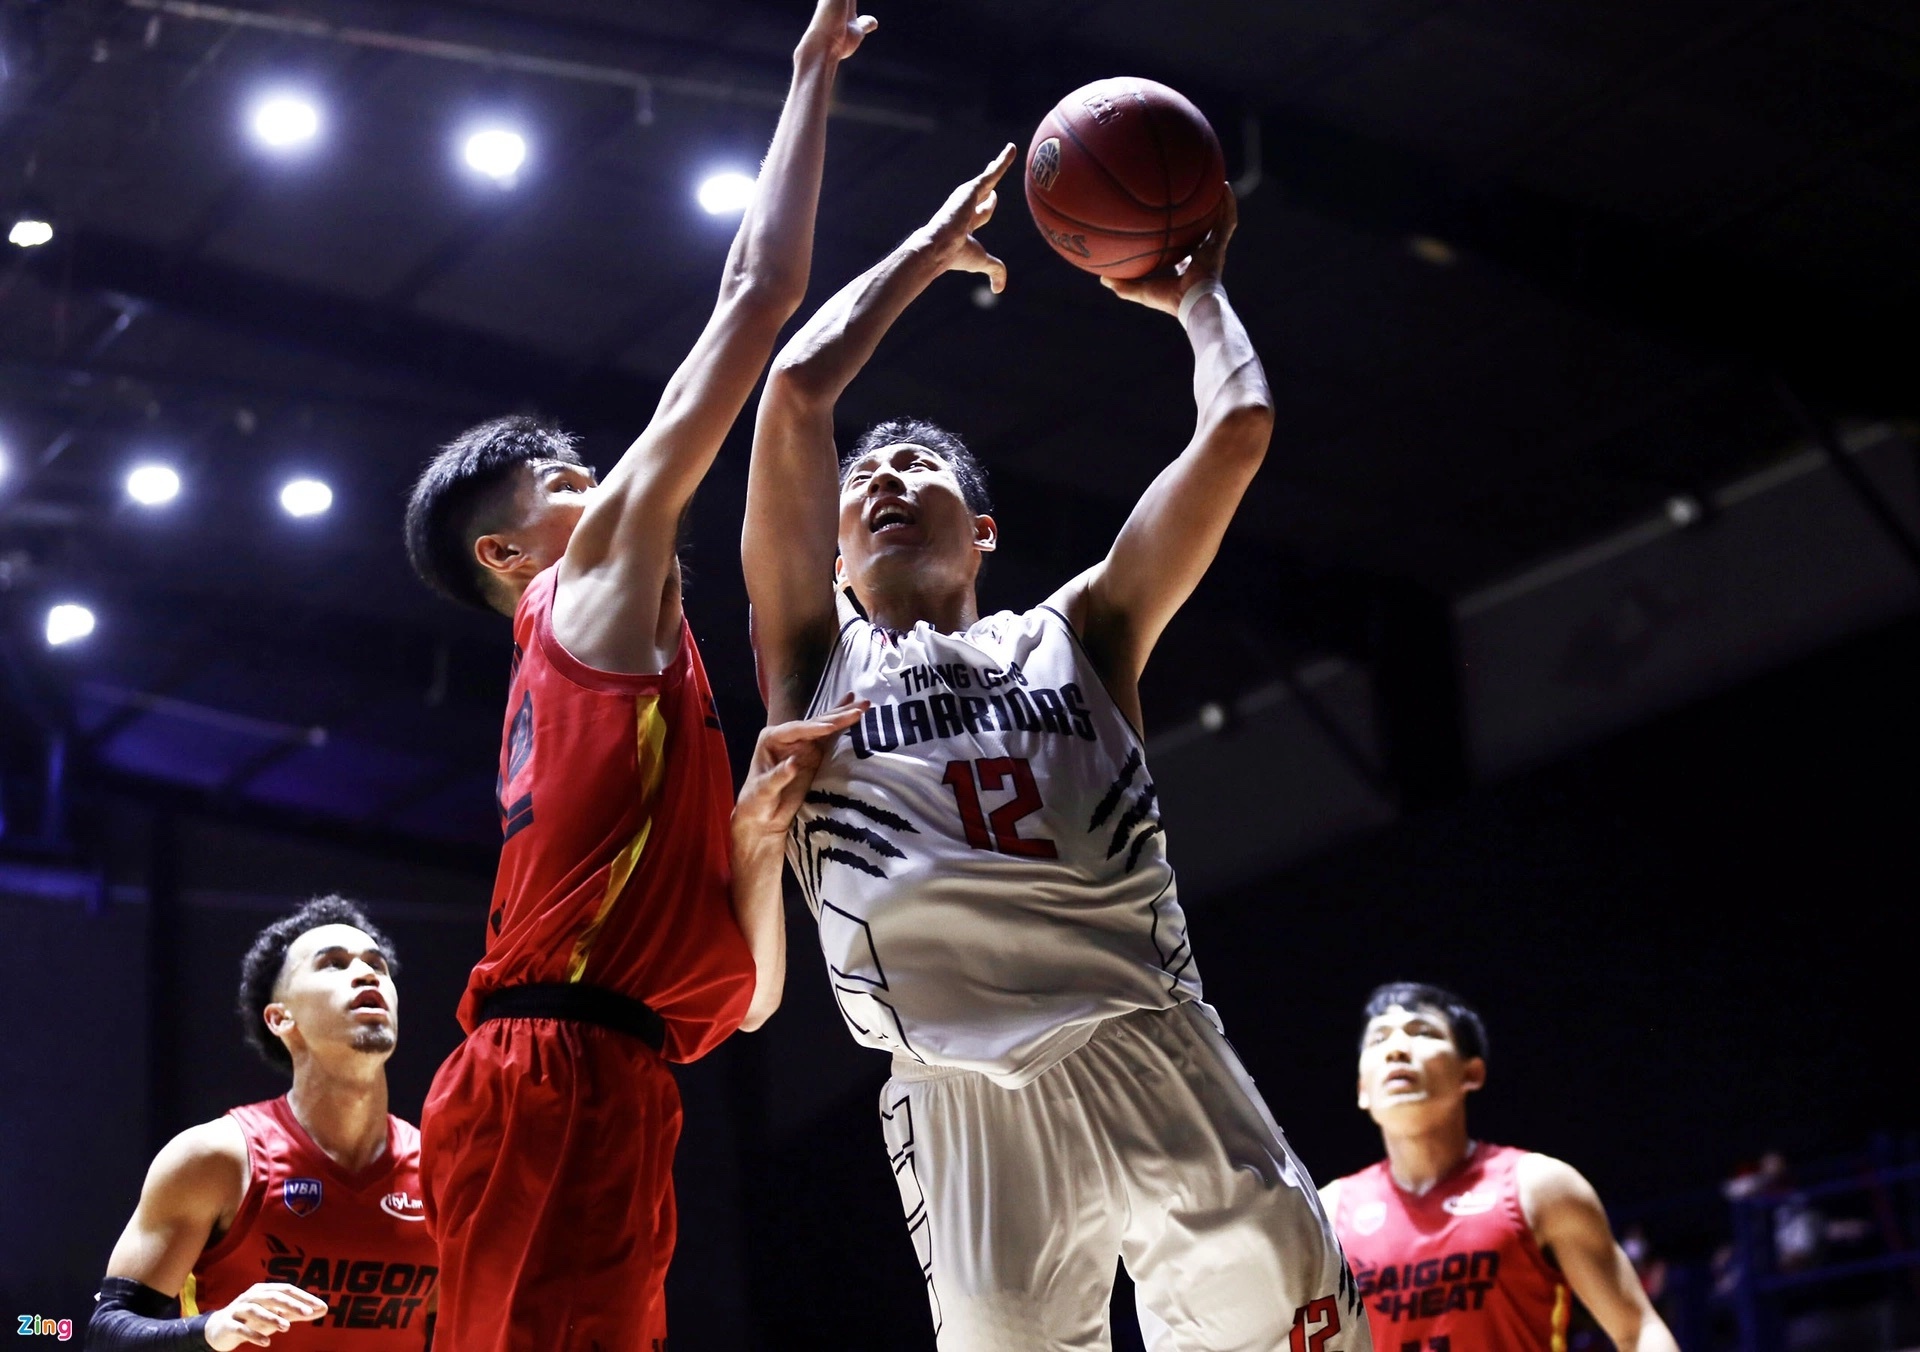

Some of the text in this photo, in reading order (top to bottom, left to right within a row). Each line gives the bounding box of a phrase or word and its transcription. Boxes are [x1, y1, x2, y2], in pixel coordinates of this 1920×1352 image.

[845, 683, 1097, 759] WARRIORS
[942, 757, 1058, 859] 12
[288, 1182, 319, 1196] VBA
[381, 1192, 424, 1219] CityLan
[265, 1256, 439, 1296] SAIGON
[1356, 1251, 1499, 1297] SAIGON
[312, 1294, 423, 1329] HEAT
[1389, 1281, 1494, 1322] HEAT
[1289, 1294, 1341, 1352] 12
